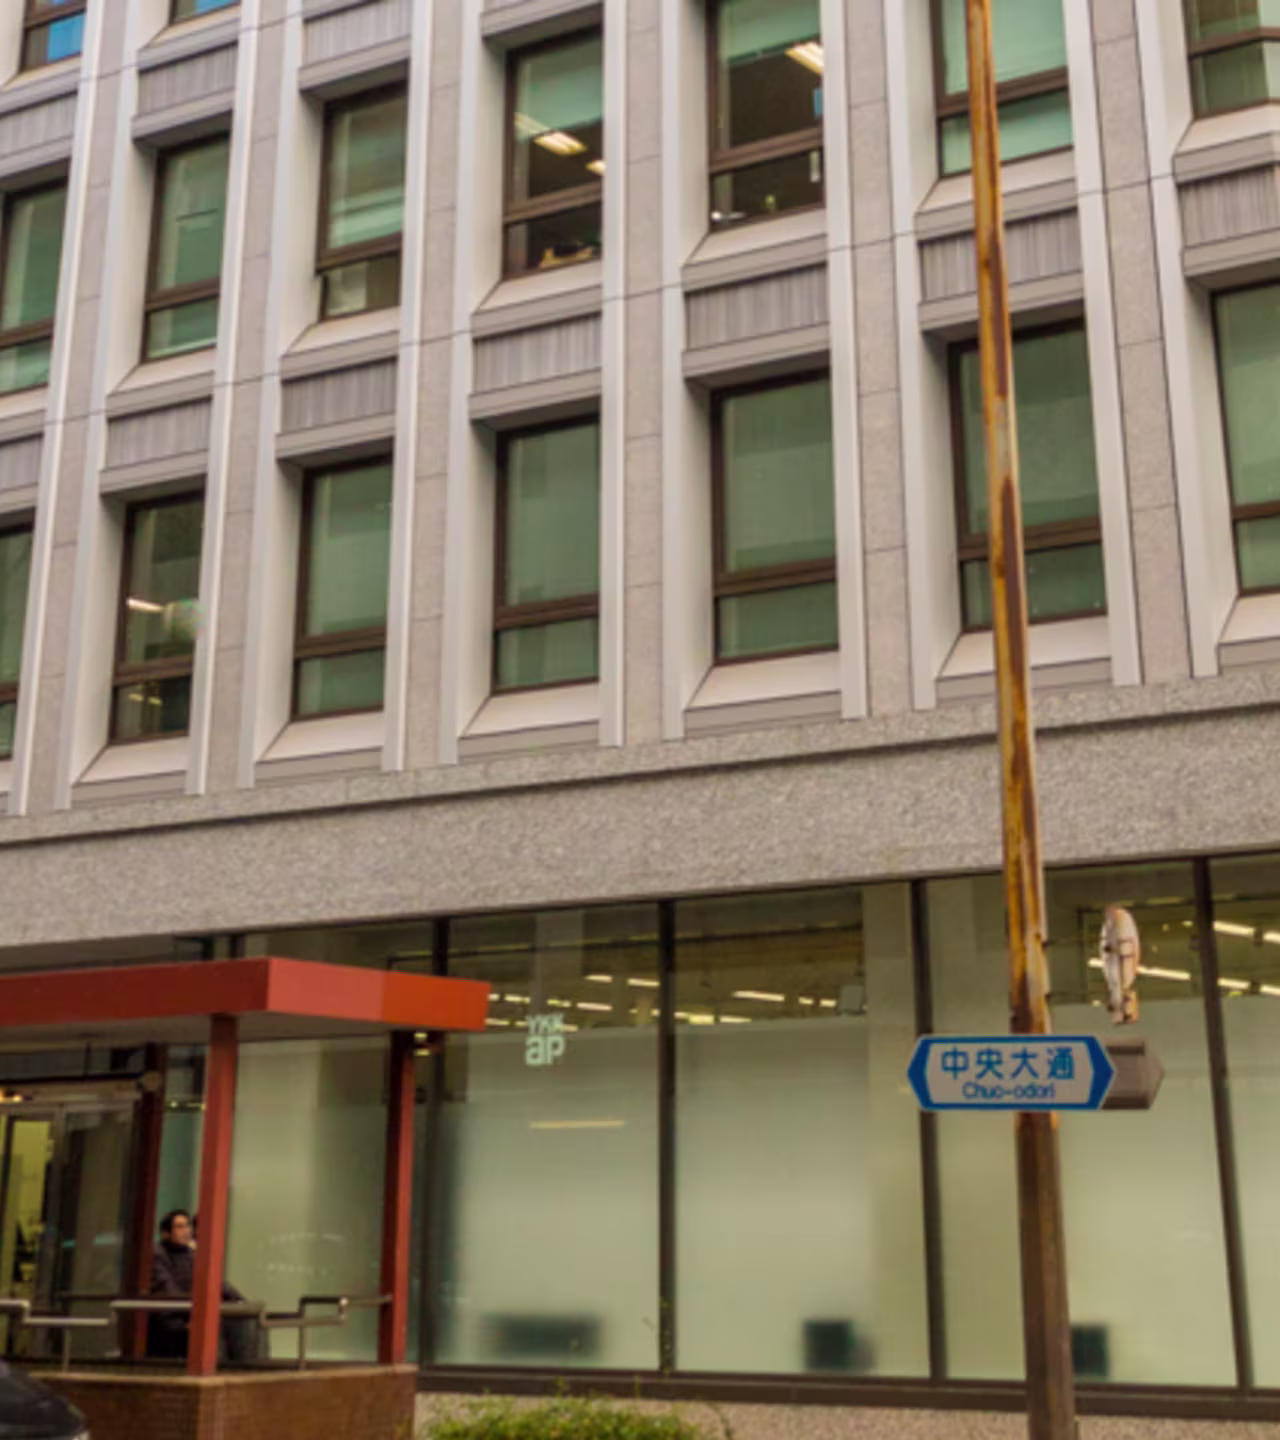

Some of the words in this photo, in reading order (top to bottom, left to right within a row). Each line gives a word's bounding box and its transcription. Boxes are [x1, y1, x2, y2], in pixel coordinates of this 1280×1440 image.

[525, 1035, 565, 1066] ap
[941, 1046, 1075, 1081] 中央大通
[962, 1081, 1057, 1099] Chuo-odori
